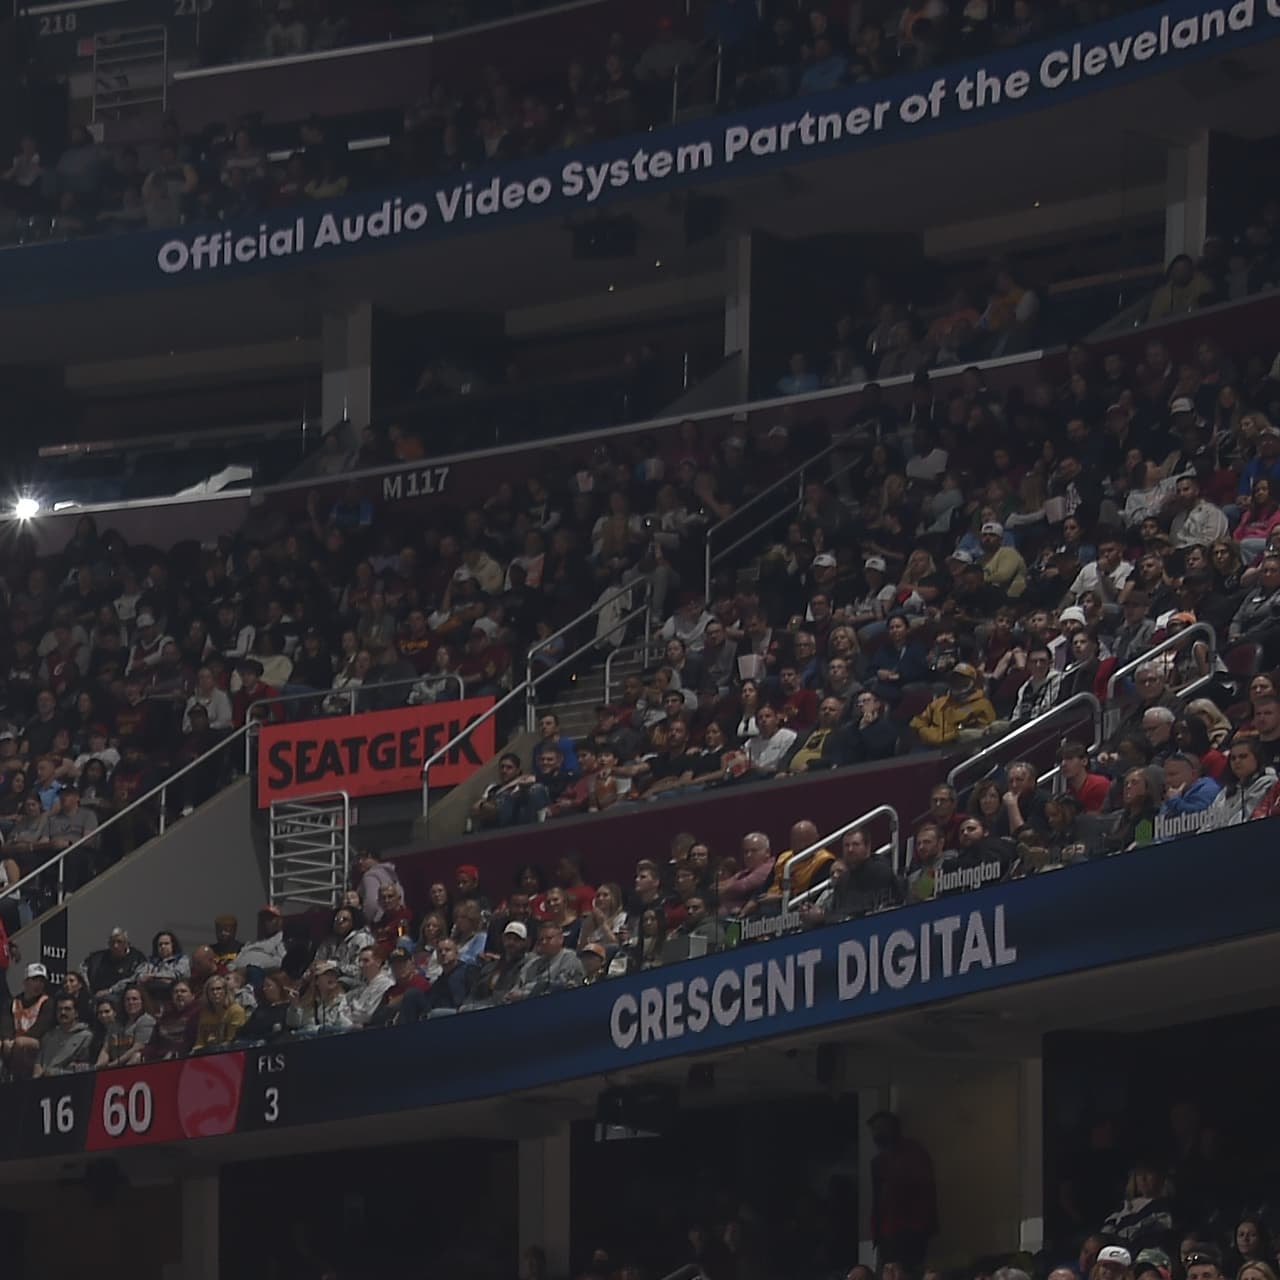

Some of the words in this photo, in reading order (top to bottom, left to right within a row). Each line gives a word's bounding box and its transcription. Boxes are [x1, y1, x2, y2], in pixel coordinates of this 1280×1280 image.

[157, 217, 305, 274] Official
[313, 201, 428, 250] Audio
[435, 177, 552, 224] Video
[561, 140, 713, 202] System
[725, 101, 891, 160] Partner
[899, 79, 947, 124] of
[955, 69, 1031, 111] the
[1039, 0, 1255, 89] Cleveland
[268, 713, 482, 790] SEATGEEK
[609, 949, 822, 1049] CRESCENT
[838, 904, 1018, 1001] DIGITAL
[257, 1054, 286, 1072] FLS
[40, 1095, 75, 1135] 16
[102, 1081, 153, 1136] 60
[263, 1087, 281, 1122] 3
